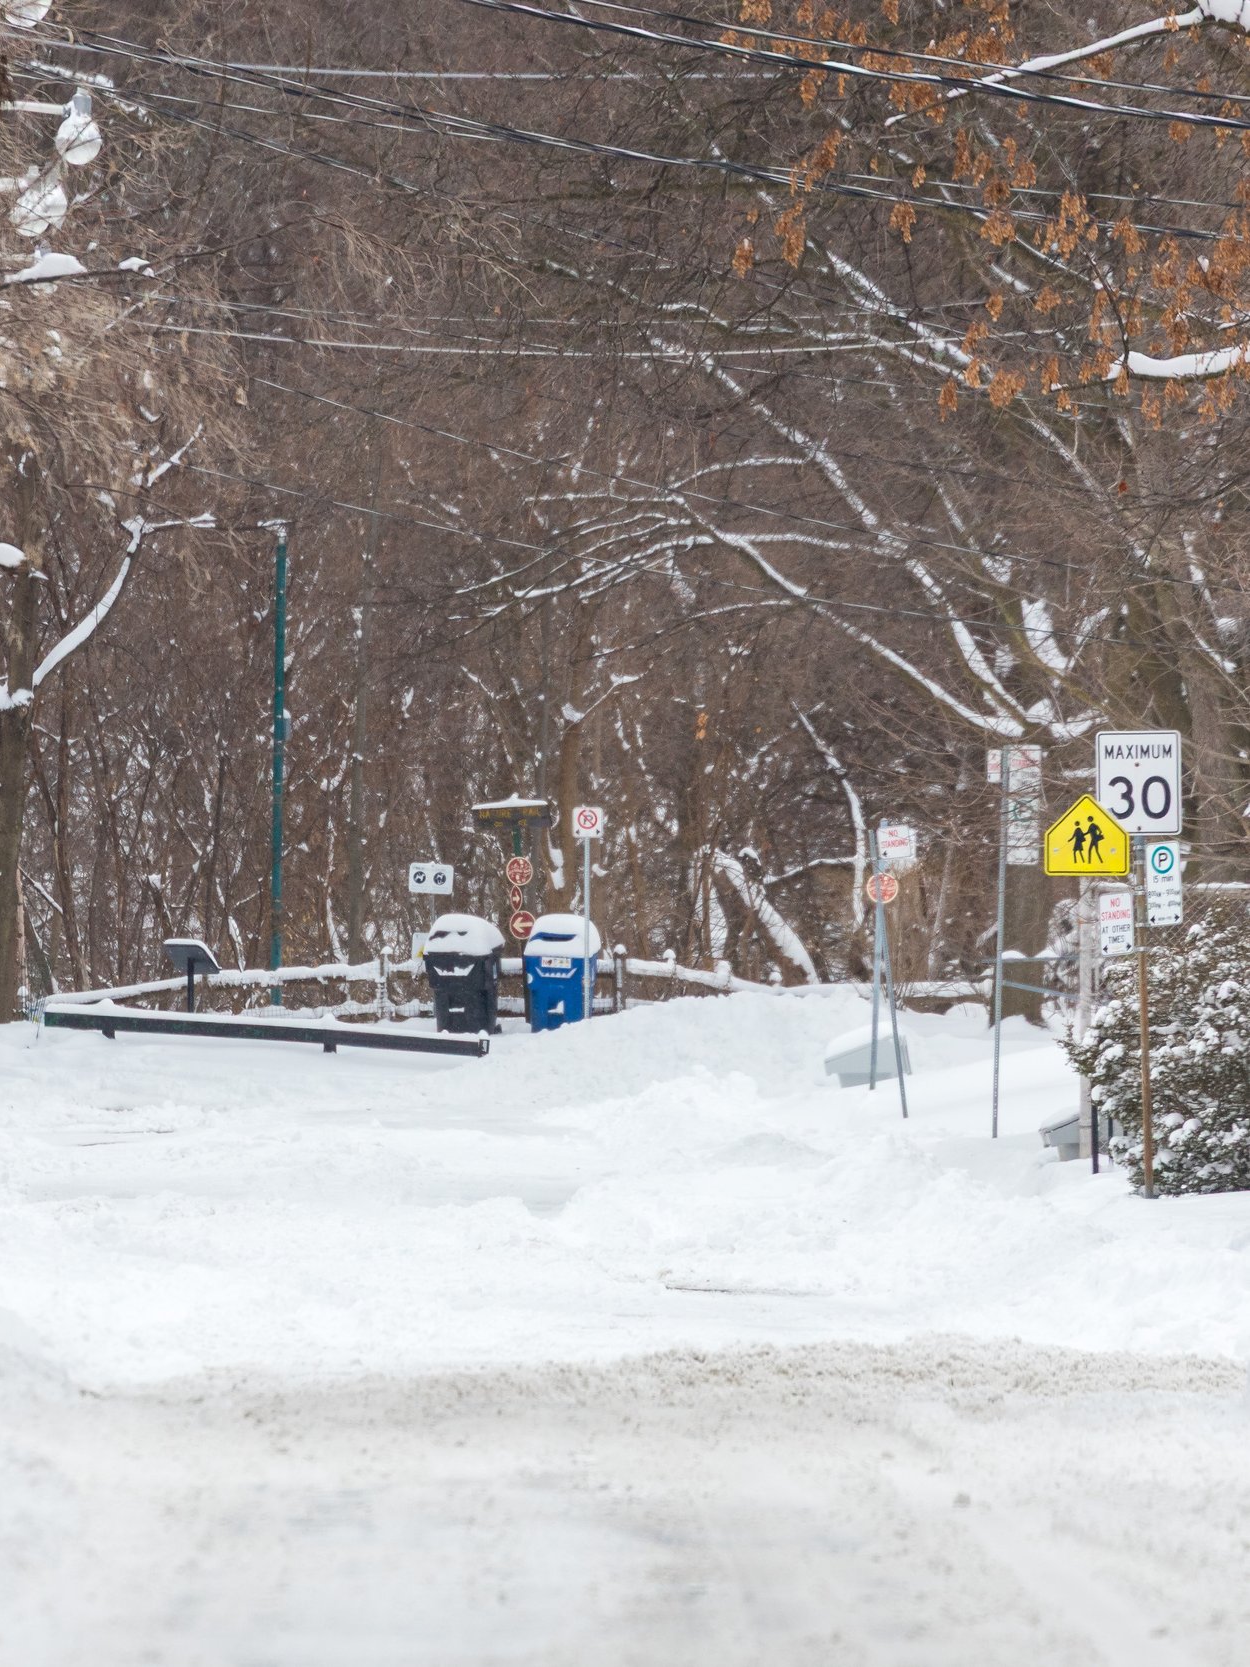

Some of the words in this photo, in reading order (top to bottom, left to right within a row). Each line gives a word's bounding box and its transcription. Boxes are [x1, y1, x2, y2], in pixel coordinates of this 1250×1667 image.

[1104, 744, 1172, 759] MAXIMUM
[1108, 775, 1172, 820] 30
[1152, 875, 1159, 884] 15
[1161, 875, 1174, 883] min
[1110, 897, 1120, 908] NO
[1101, 909, 1131, 921] STANDING
[1102, 926, 1109, 934] AT
[1111, 923, 1131, 934] OTHER
[1108, 934, 1125, 944] TIMES
